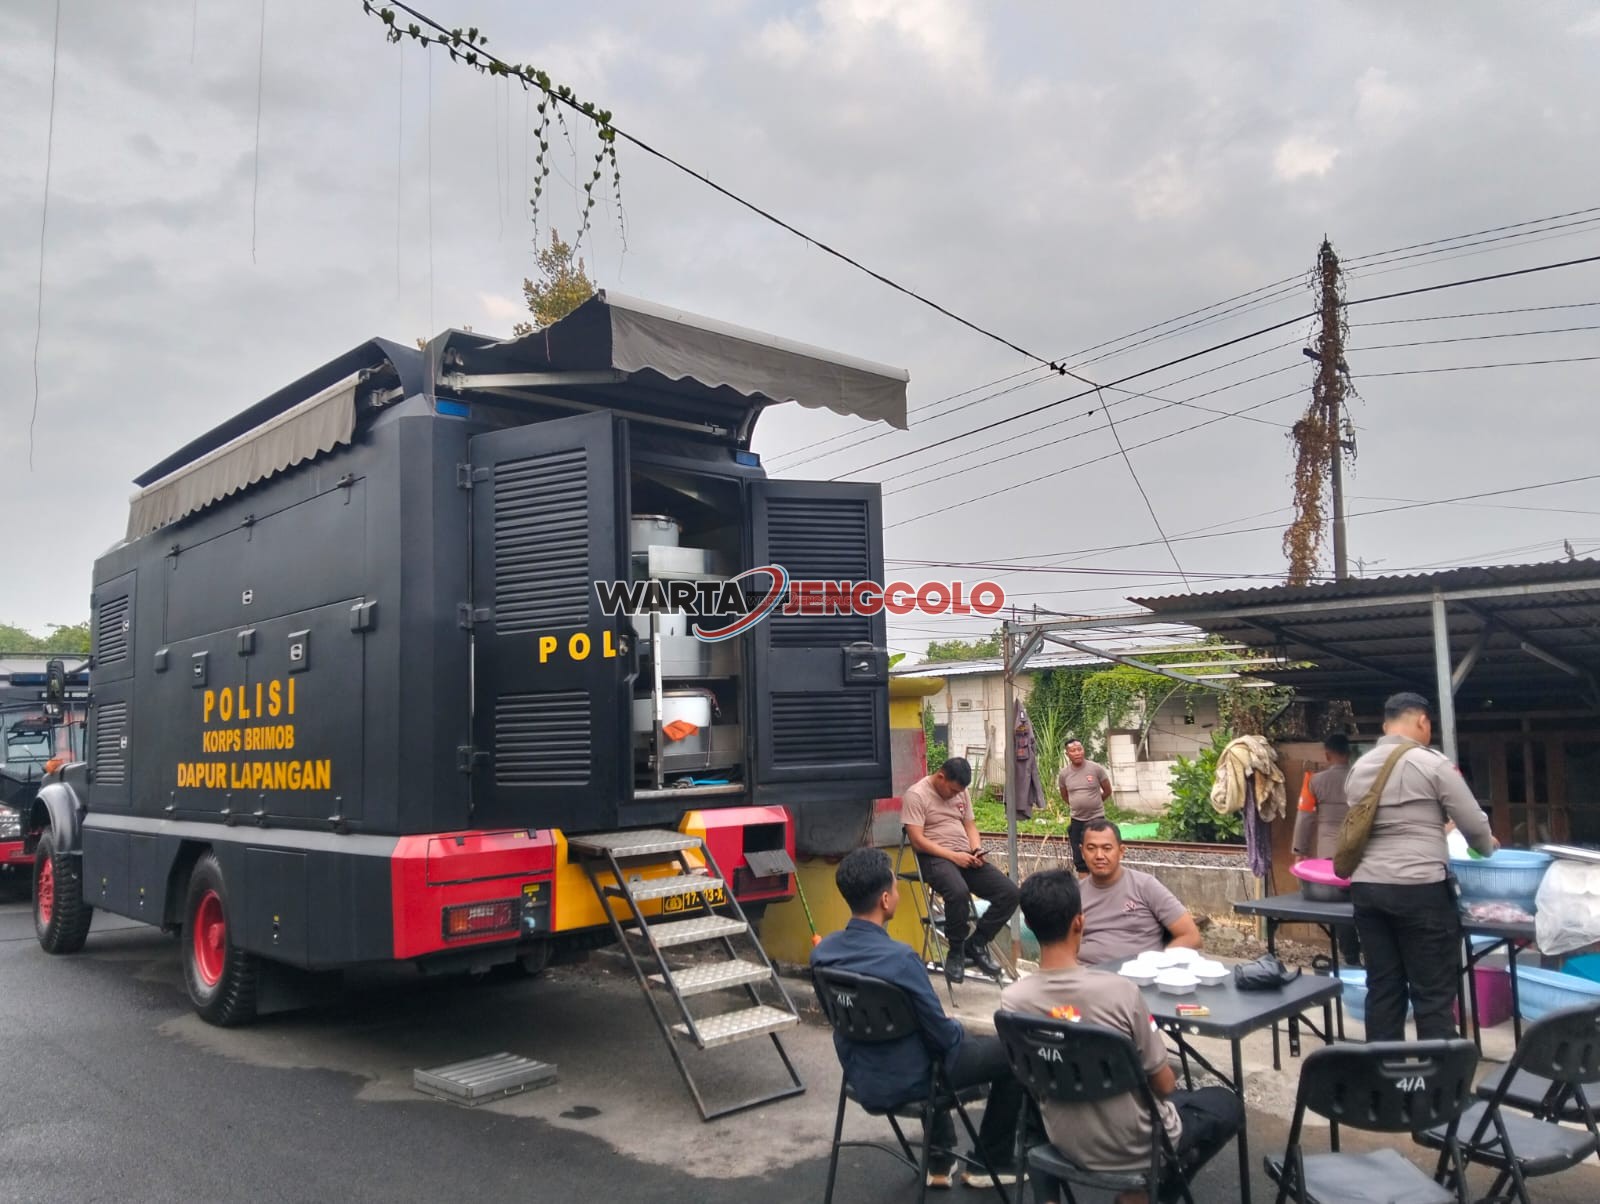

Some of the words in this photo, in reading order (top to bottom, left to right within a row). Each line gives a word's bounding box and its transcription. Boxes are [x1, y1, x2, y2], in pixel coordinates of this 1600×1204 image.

[538, 630, 617, 664] POL
[203, 677, 295, 724] POLISI
[203, 729, 241, 753] KORPS
[243, 724, 295, 751] BRIMOB
[177, 762, 227, 789] DAPUR
[231, 759, 331, 790] LAPANGAN
[1395, 1076, 1426, 1092] 4/A
